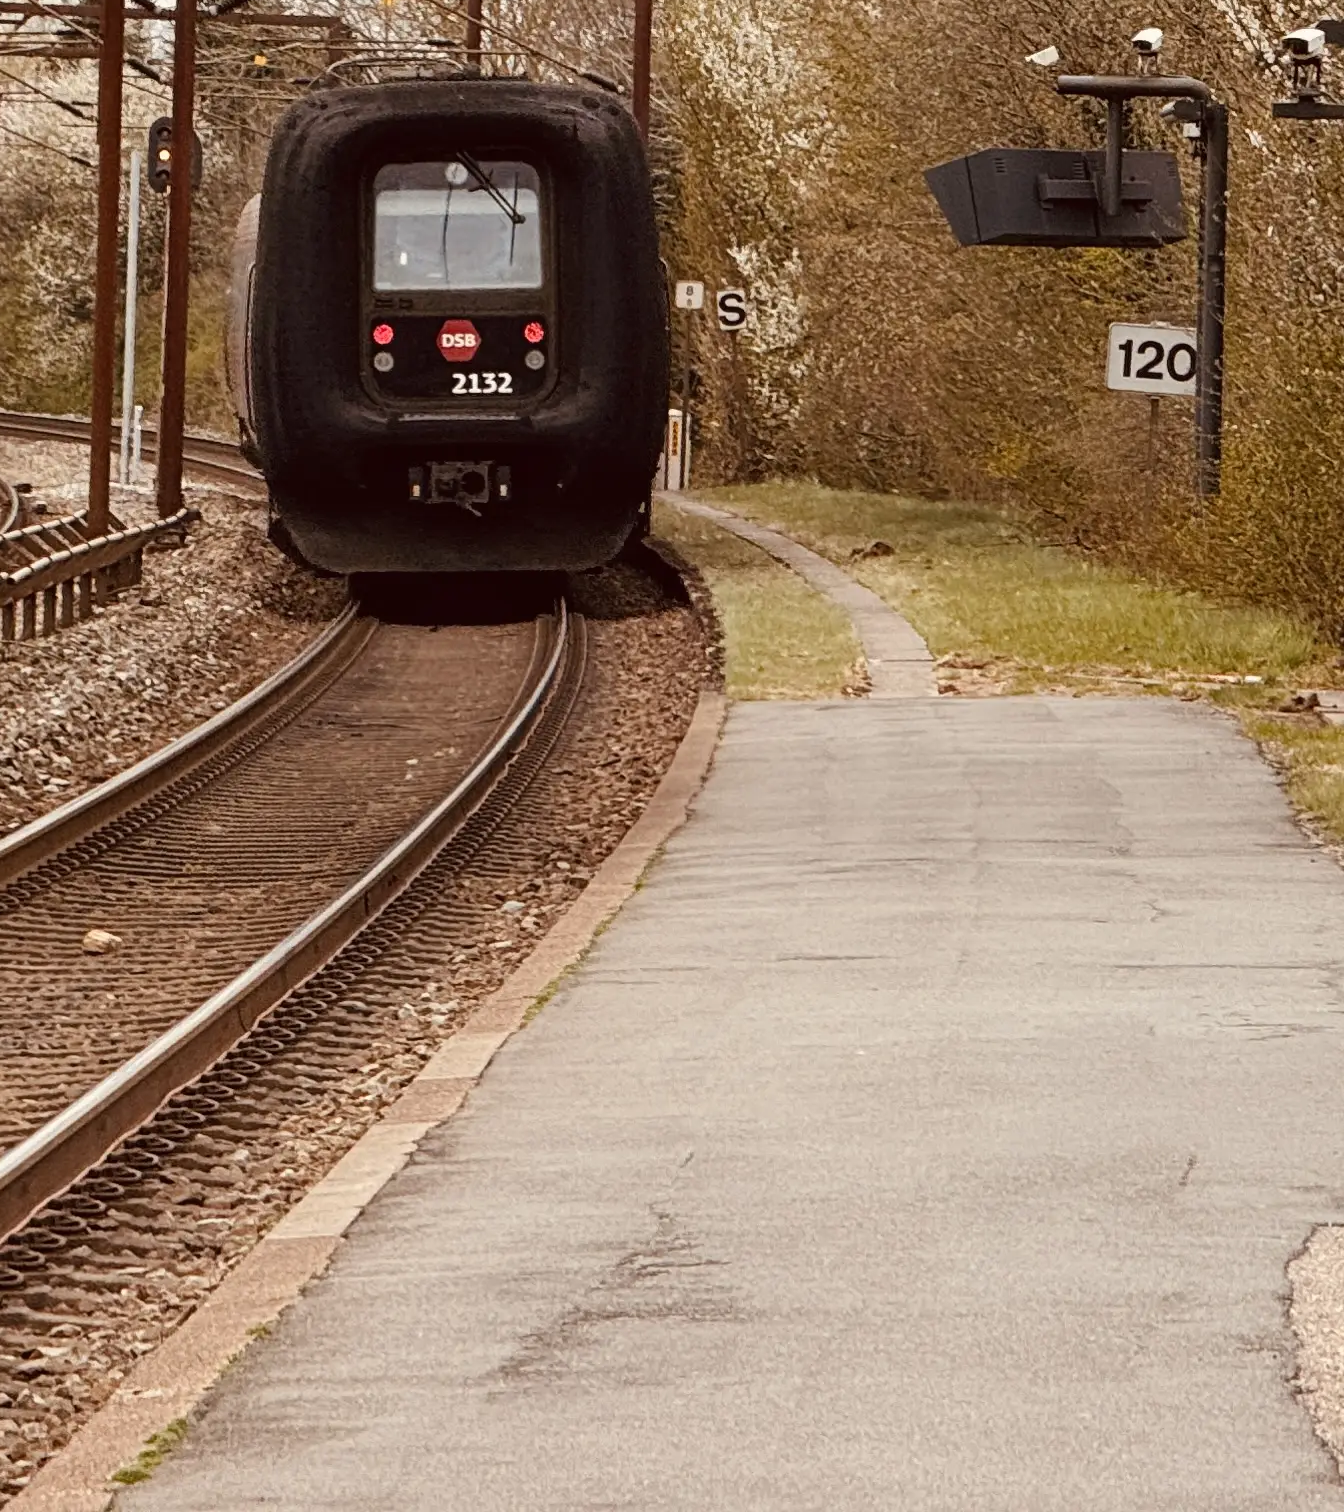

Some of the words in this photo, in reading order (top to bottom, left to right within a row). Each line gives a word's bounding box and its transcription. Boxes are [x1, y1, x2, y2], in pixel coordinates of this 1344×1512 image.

[719, 293, 747, 326] S
[441, 333, 477, 348] DSB
[1118, 339, 1197, 382] 120
[451, 372, 513, 395] 2132
